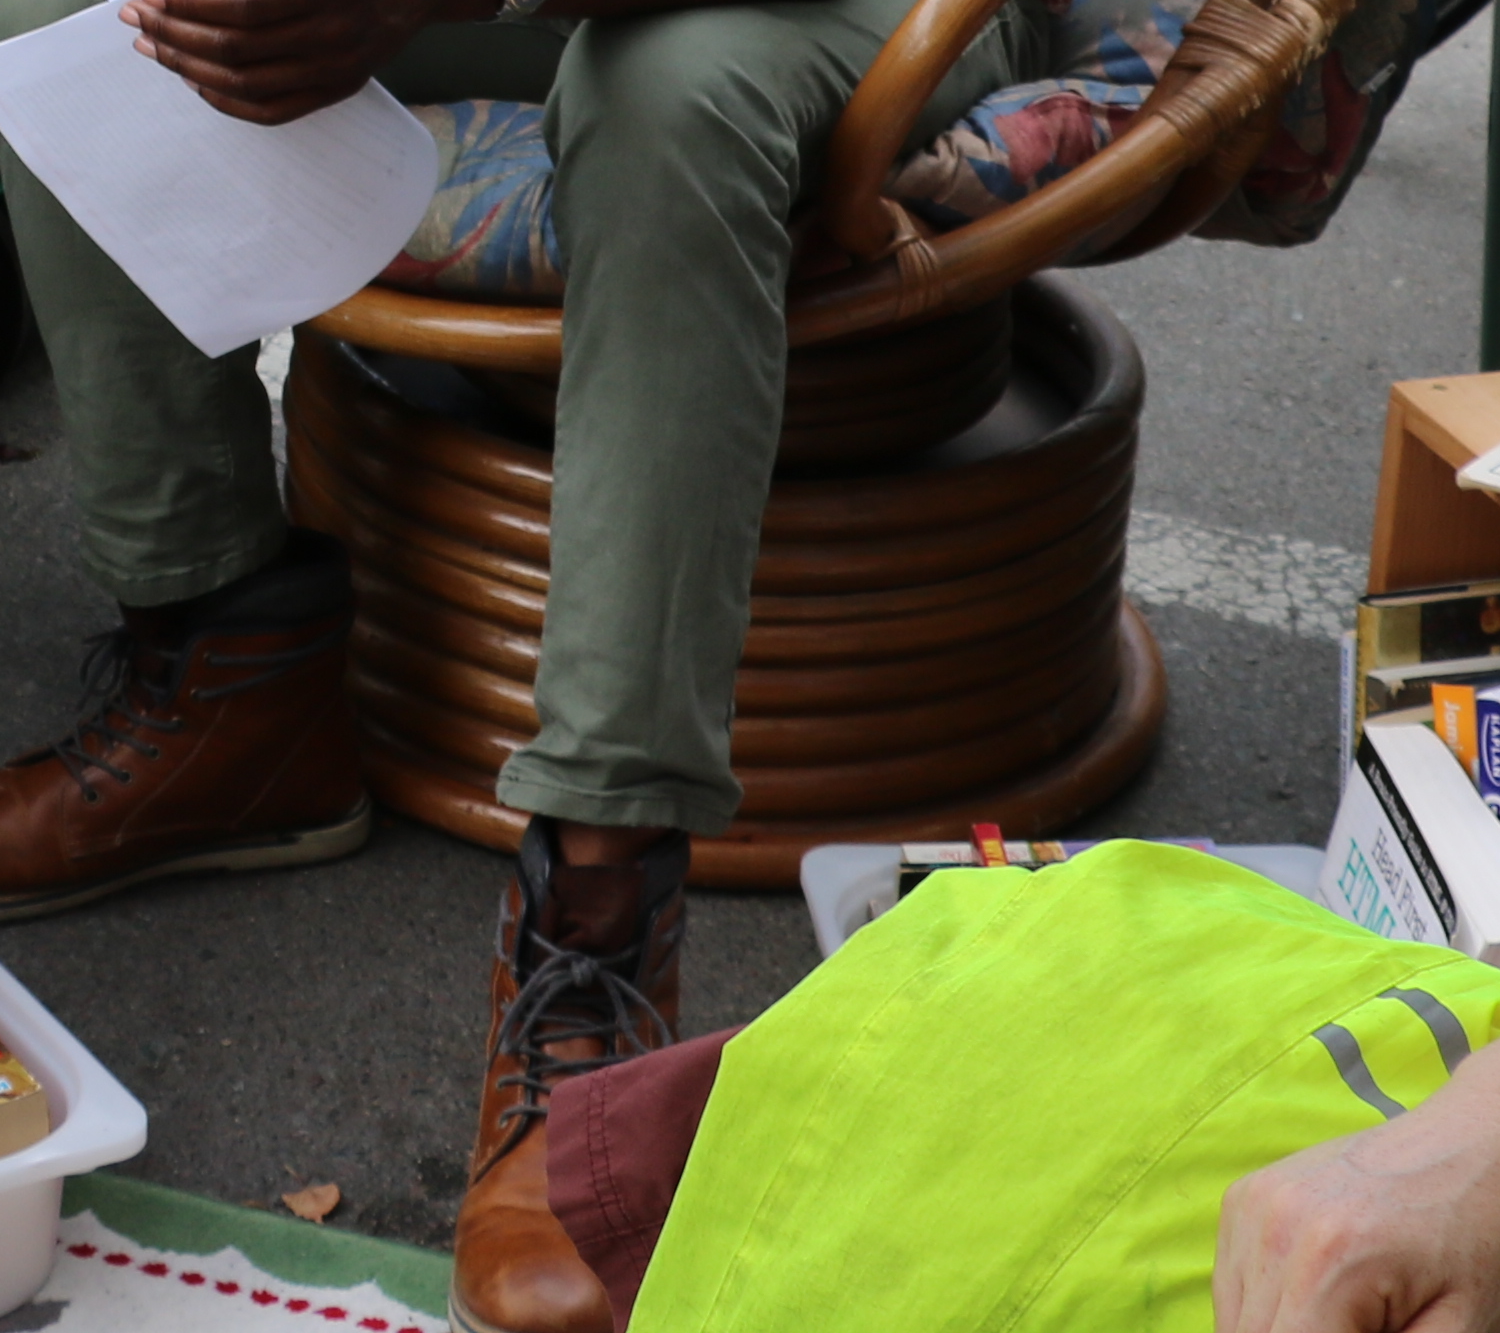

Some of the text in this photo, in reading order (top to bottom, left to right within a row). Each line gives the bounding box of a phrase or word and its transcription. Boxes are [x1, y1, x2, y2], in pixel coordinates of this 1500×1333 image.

[1337, 836, 1397, 939] HTM
[1371, 826, 1429, 942] Head First
